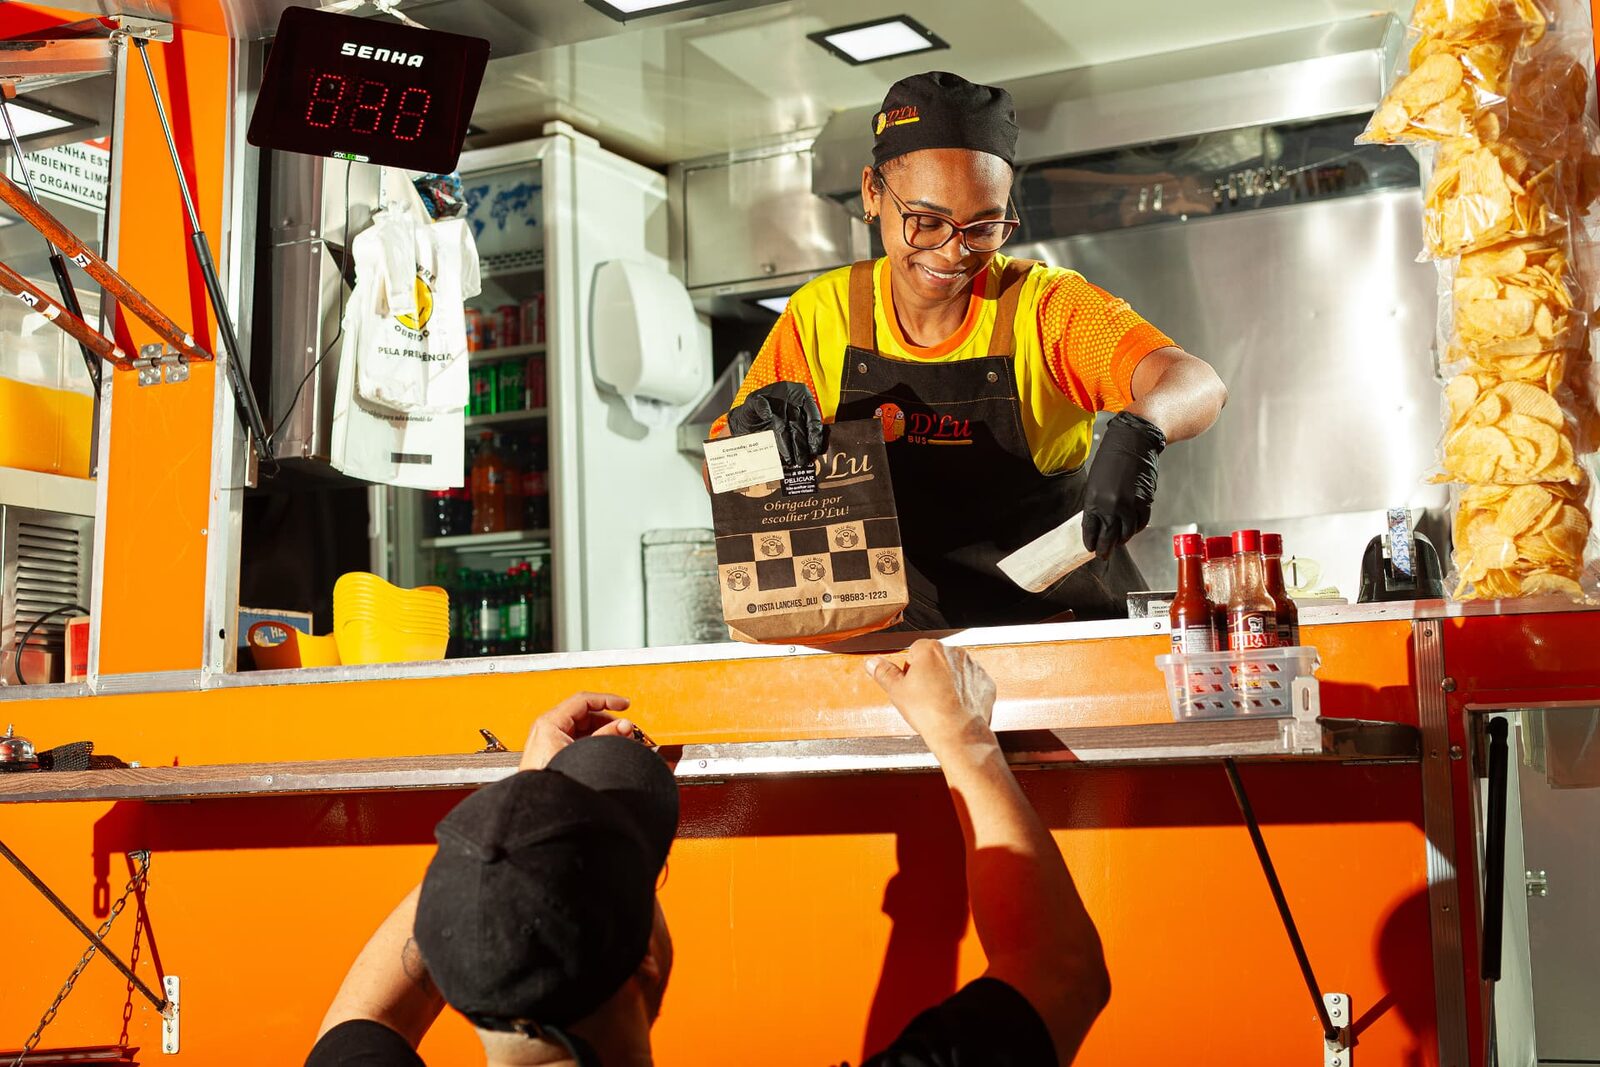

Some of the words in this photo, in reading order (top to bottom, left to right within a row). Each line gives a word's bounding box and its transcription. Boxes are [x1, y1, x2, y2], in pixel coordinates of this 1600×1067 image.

[340, 42, 424, 68] SENHA
[24, 152, 81, 176] AMBIENTE
[29, 170, 36, 180] E
[39, 173, 107, 201] ORGANIZAD
[378, 346, 400, 356] PELA
[910, 413, 973, 438] D'Lu
[907, 435, 927, 445] BUS
[783, 475, 815, 485] DELICIAR
[763, 496, 819, 512] Obrigado
[820, 496, 843, 509] por
[761, 509, 810, 525] escolher
[811, 506, 850, 521] D'Lu!
[757, 602, 776, 612] INSTA
[840, 590, 888, 603] 98583-1223
[1231, 631, 1279, 650] PIRATA
